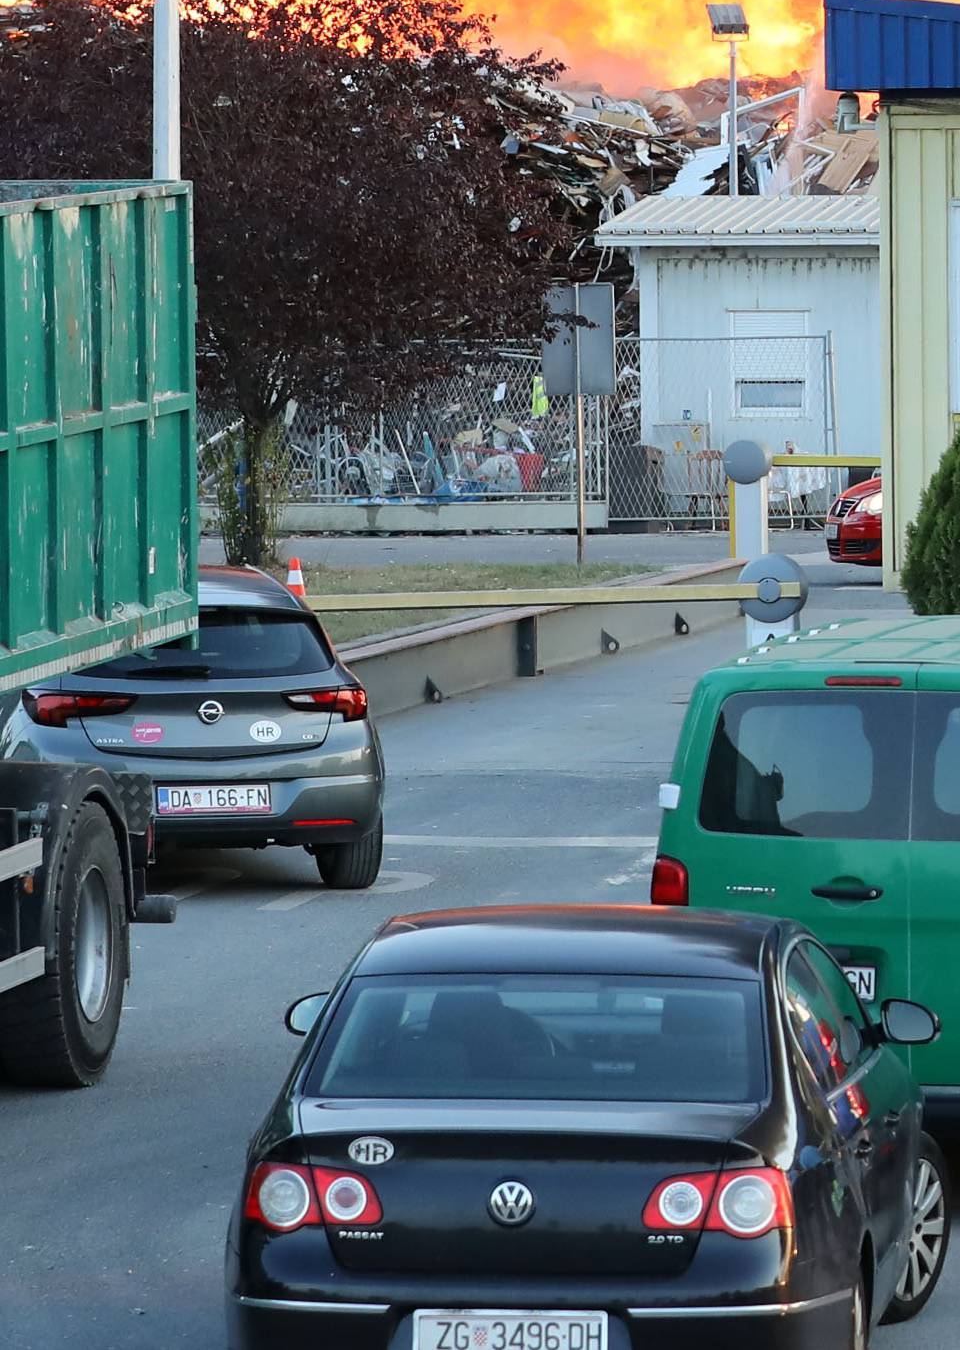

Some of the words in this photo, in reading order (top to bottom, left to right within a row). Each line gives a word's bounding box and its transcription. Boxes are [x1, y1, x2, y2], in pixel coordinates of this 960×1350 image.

[256, 727, 275, 738] HR
[171, 790, 191, 807] DA
[354, 1142, 388, 1162] HR
[338, 1230, 384, 1241] PASSAT
[436, 1322, 470, 1350] ZG
